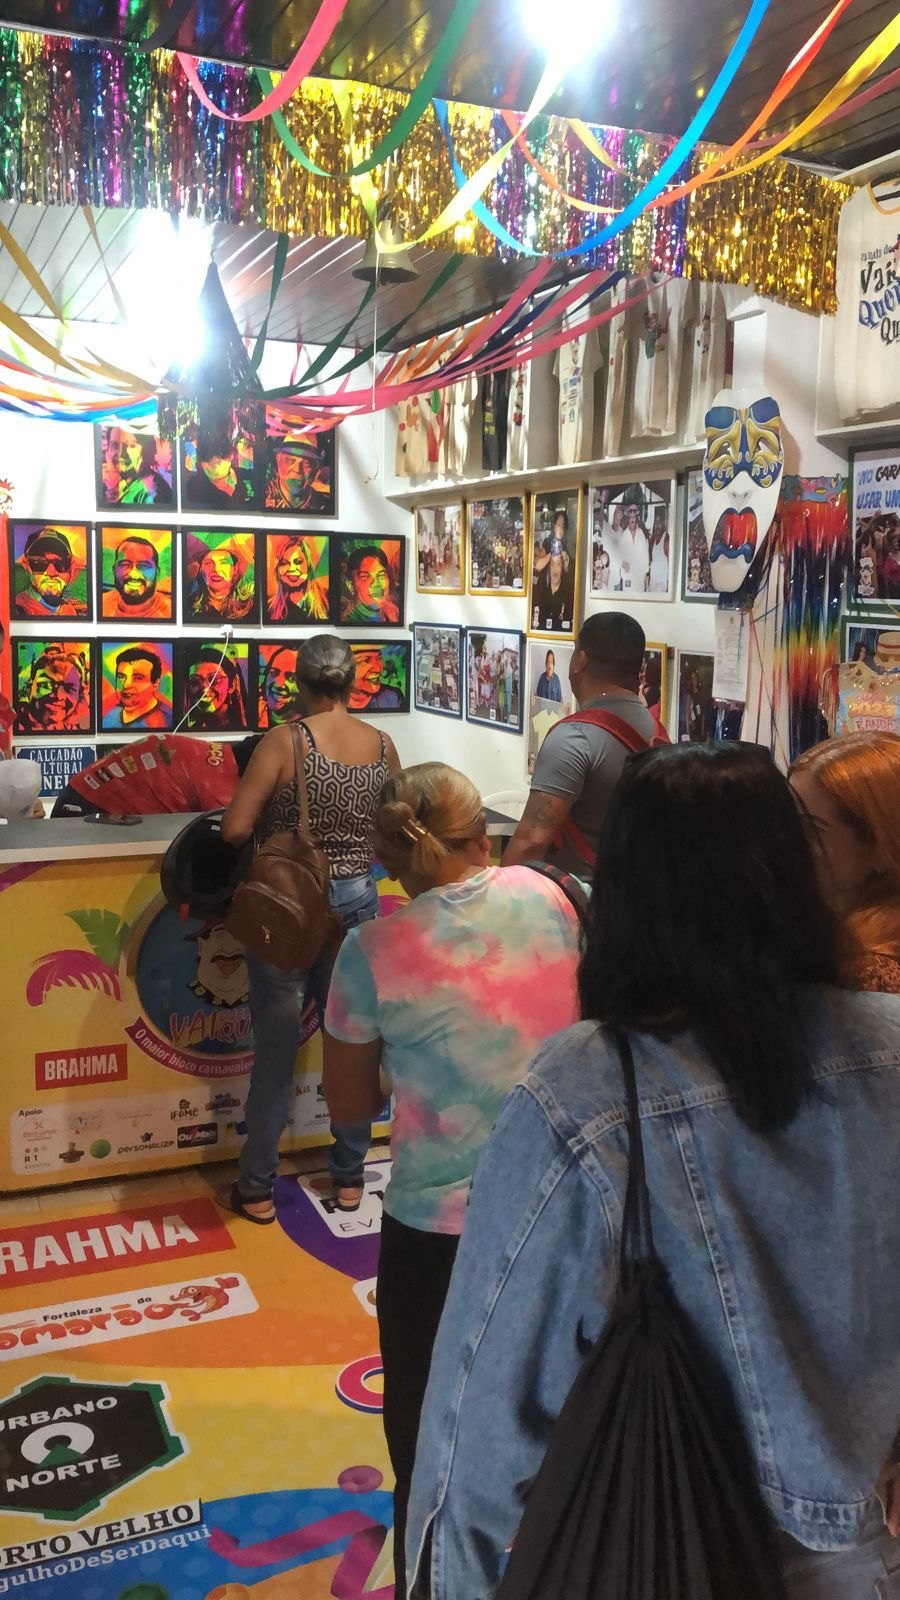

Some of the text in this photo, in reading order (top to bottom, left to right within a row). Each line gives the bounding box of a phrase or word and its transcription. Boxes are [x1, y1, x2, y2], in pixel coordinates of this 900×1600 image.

[856, 491, 882, 509] USAR
[43, 761, 82, 775] LTURA
[44, 1053, 118, 1081] BRAHMA
[167, 1051, 197, 1072] bloco
[0, 1214, 200, 1275] RAHMA
[42, 1295, 153, 1323] Fortaleza do
[5, 1453, 122, 1492] NORTE
[0, 1504, 194, 1567] RTO VELHO
[0, 1524, 212, 1593] gulhoDeSerDaqui
